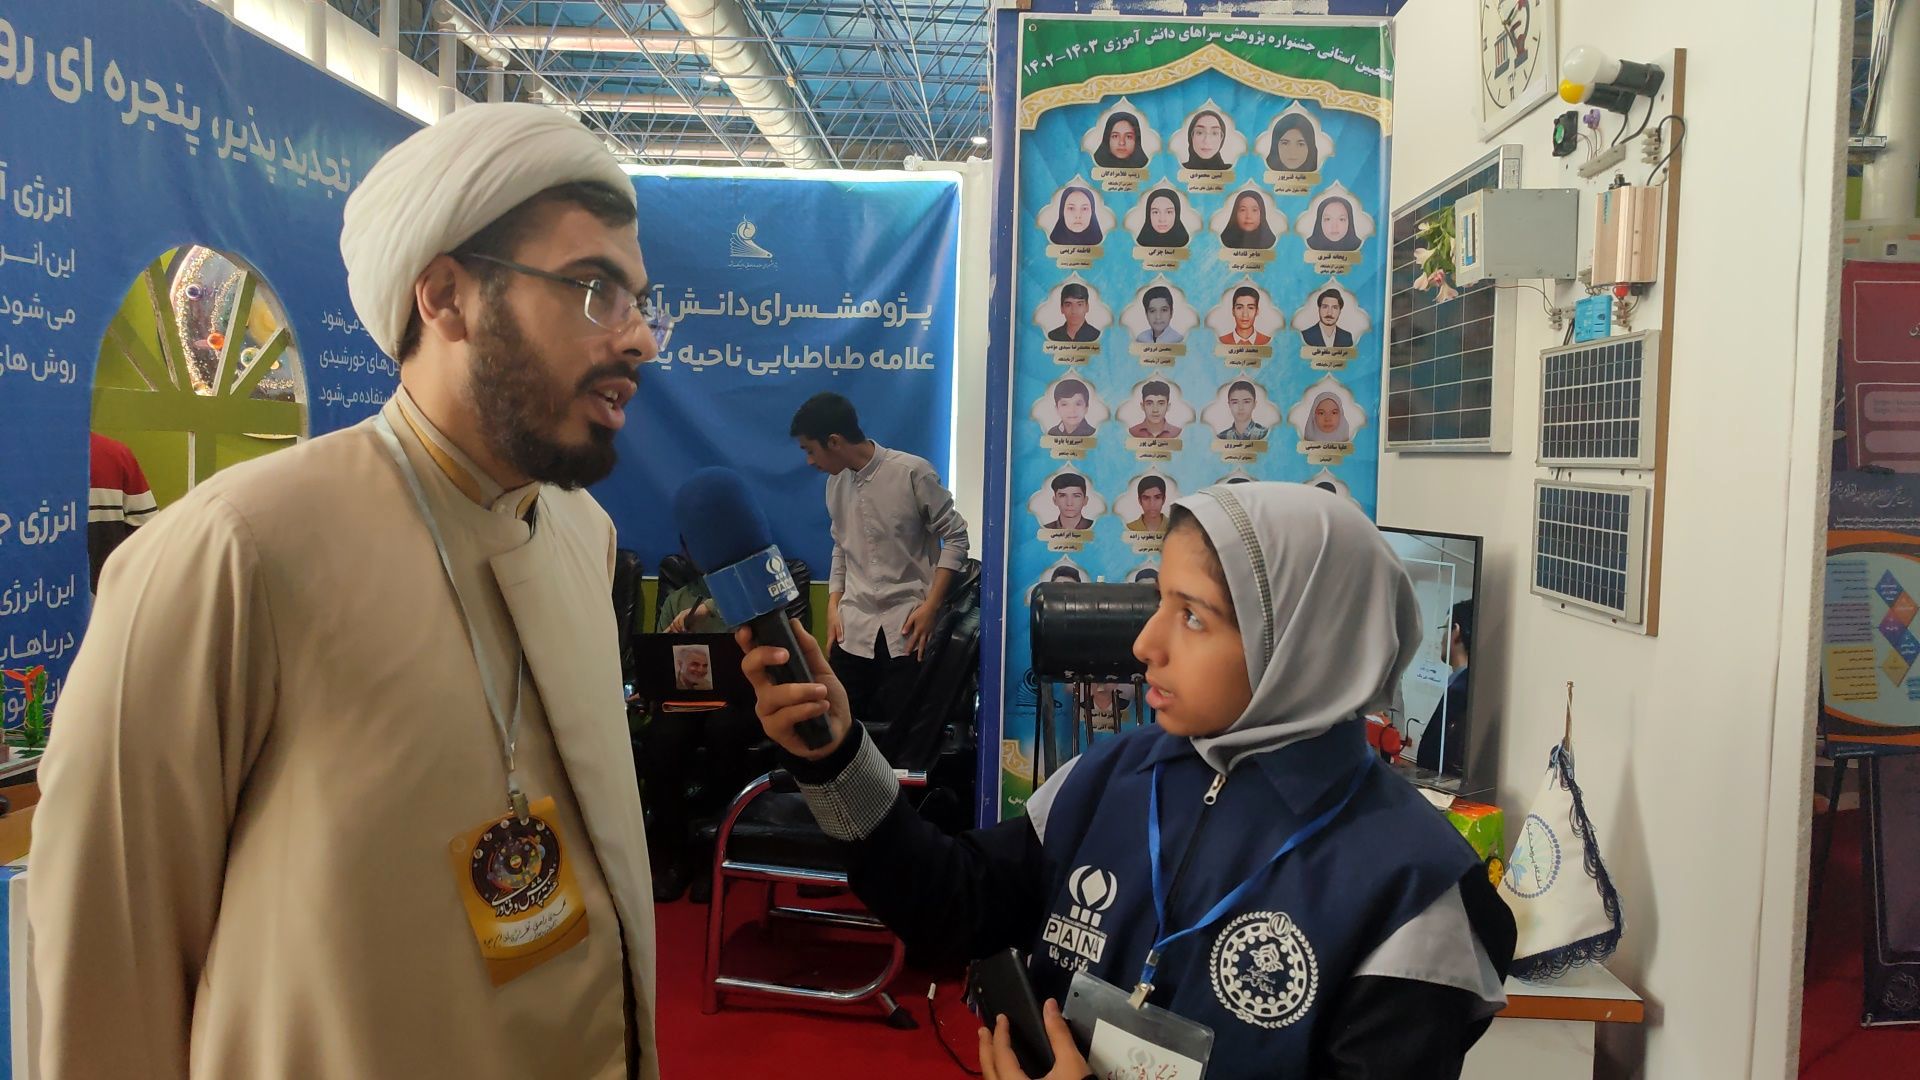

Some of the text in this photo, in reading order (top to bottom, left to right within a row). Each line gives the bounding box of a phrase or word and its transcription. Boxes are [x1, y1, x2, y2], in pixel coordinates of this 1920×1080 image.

[1104, 29, 1141, 53] آموزی
[1145, 27, 1176, 45] دانش
[1224, 27, 1265, 47] پژوهش
[1268, 34, 1315, 55] جشنواره
[46, 37, 93, 104] ای
[1317, 46, 1356, 65] استانی
[103, 59, 201, 156] پنجره
[282, 136, 350, 199] تجدید
[14, 174, 72, 223] انرژی
[46, 248, 76, 279] این
[664, 287, 750, 323] دانش
[31, 348, 76, 384] روش
[319, 346, 366, 372] خورشیدی
[678, 343, 742, 372] ناحیه
[747, 344, 864, 376] طباطبایی
[869, 346, 935, 370] علامه
[19, 499, 76, 545] انرژی
[46, 574, 75, 609] این
